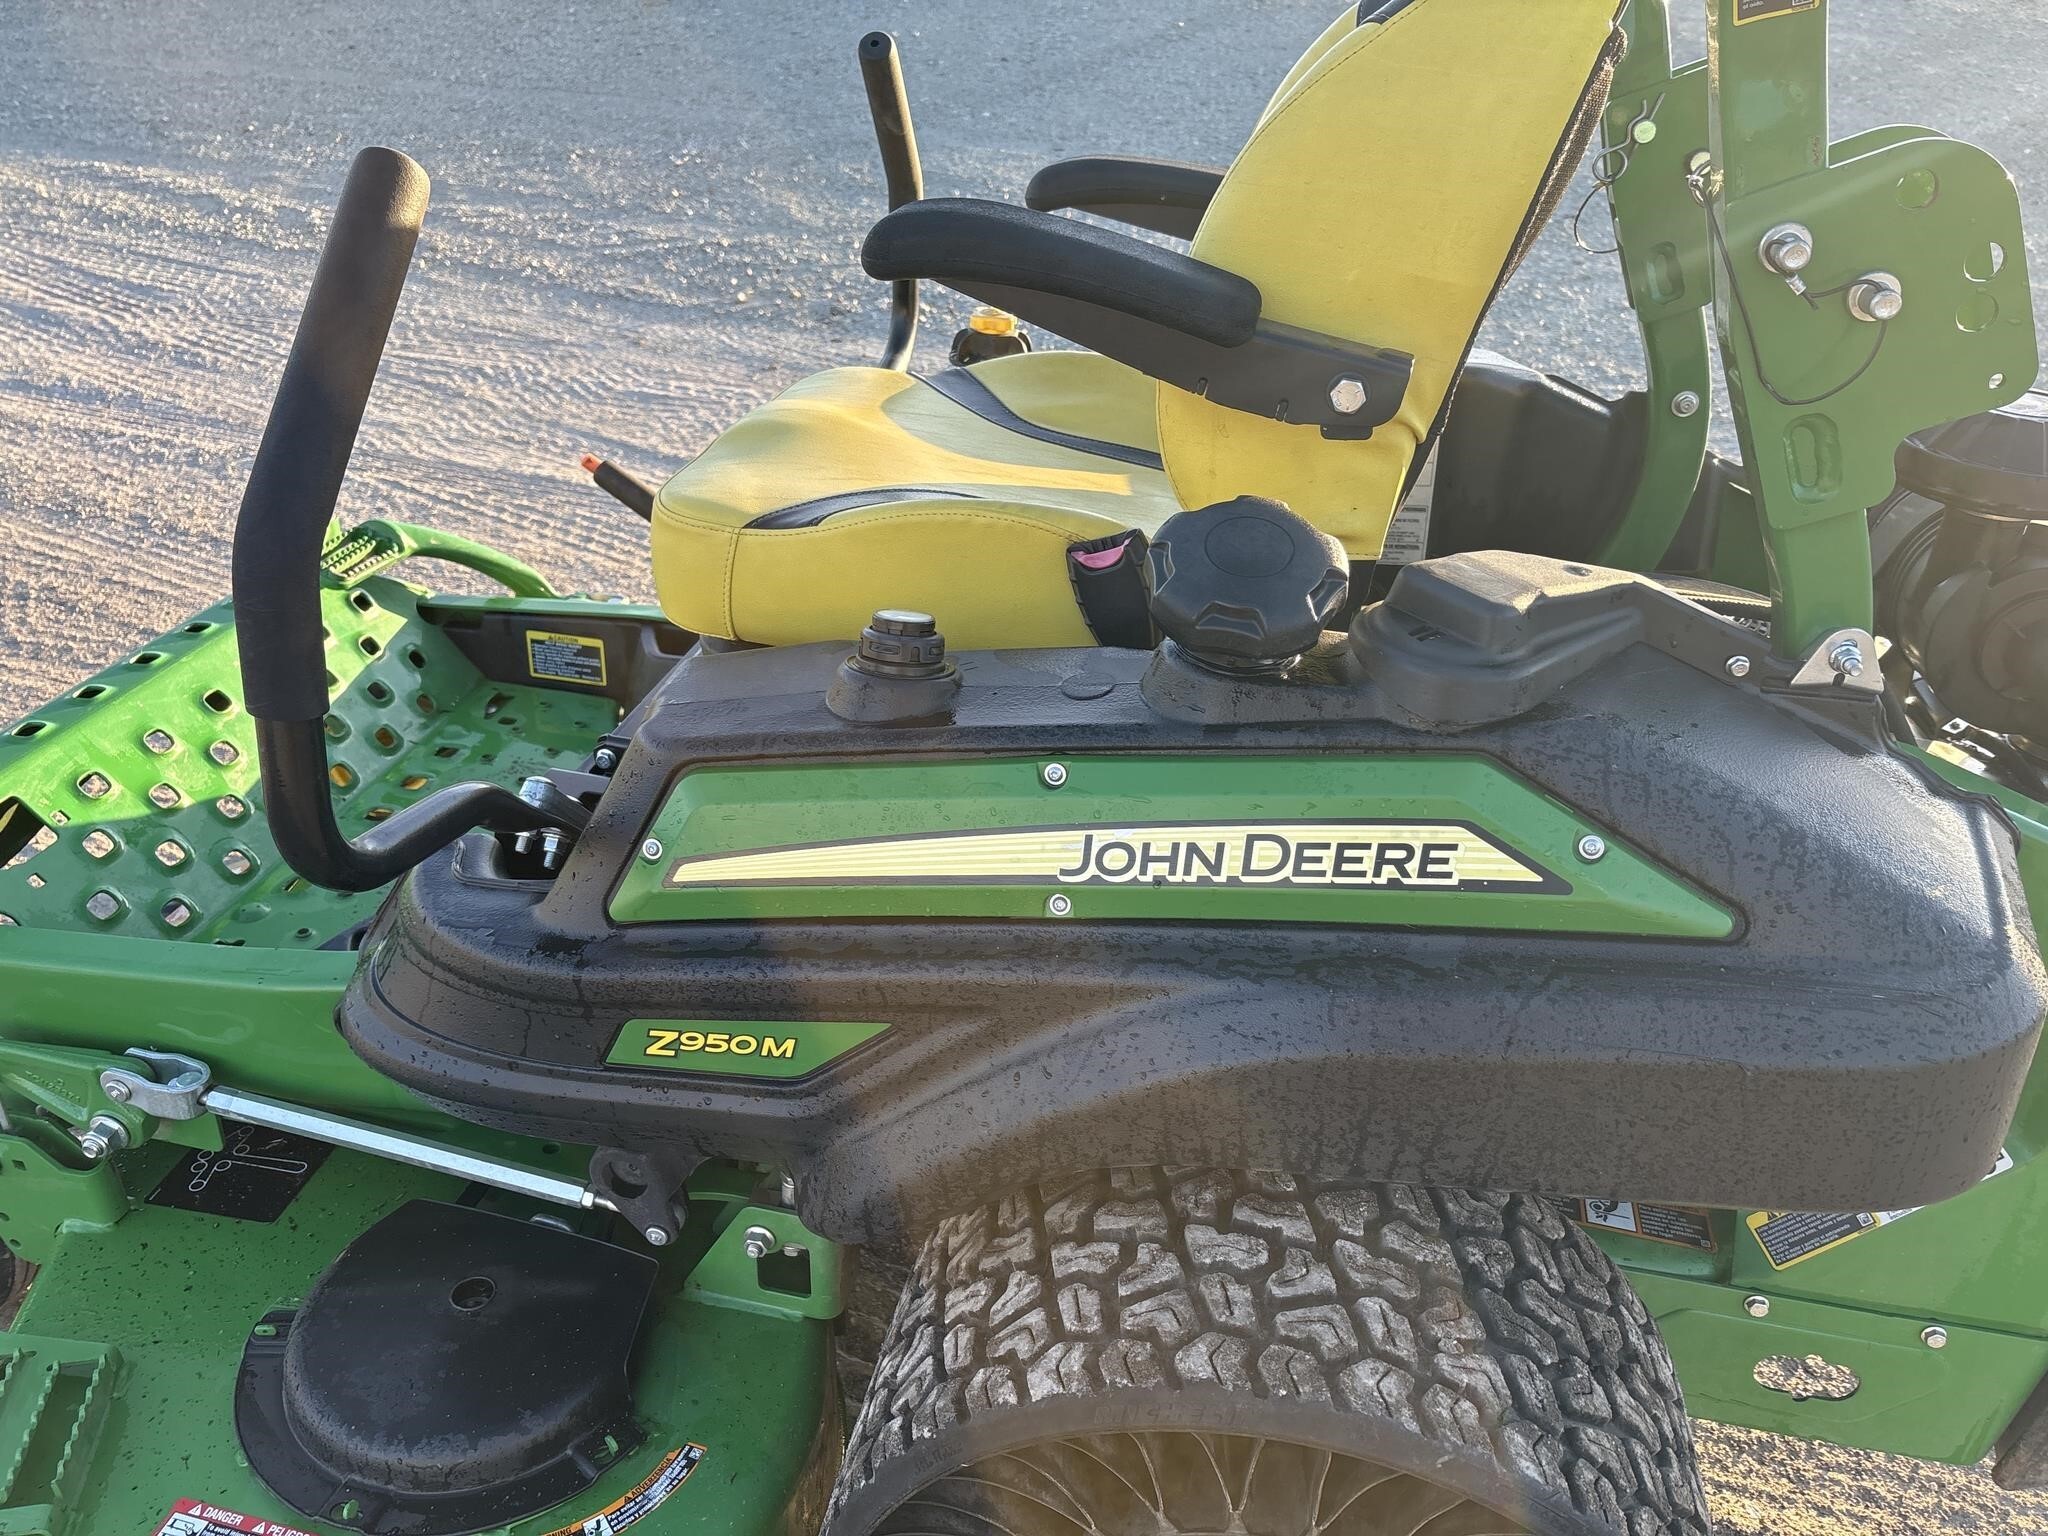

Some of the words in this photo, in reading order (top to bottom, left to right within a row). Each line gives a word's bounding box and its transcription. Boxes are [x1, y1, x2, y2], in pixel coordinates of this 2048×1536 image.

[1059, 834, 1222, 877] JOHN
[1241, 834, 1459, 880] DEERE
[631, 1457, 673, 1498] ADVERTENCIA
[203, 1507, 244, 1526] DANGER
